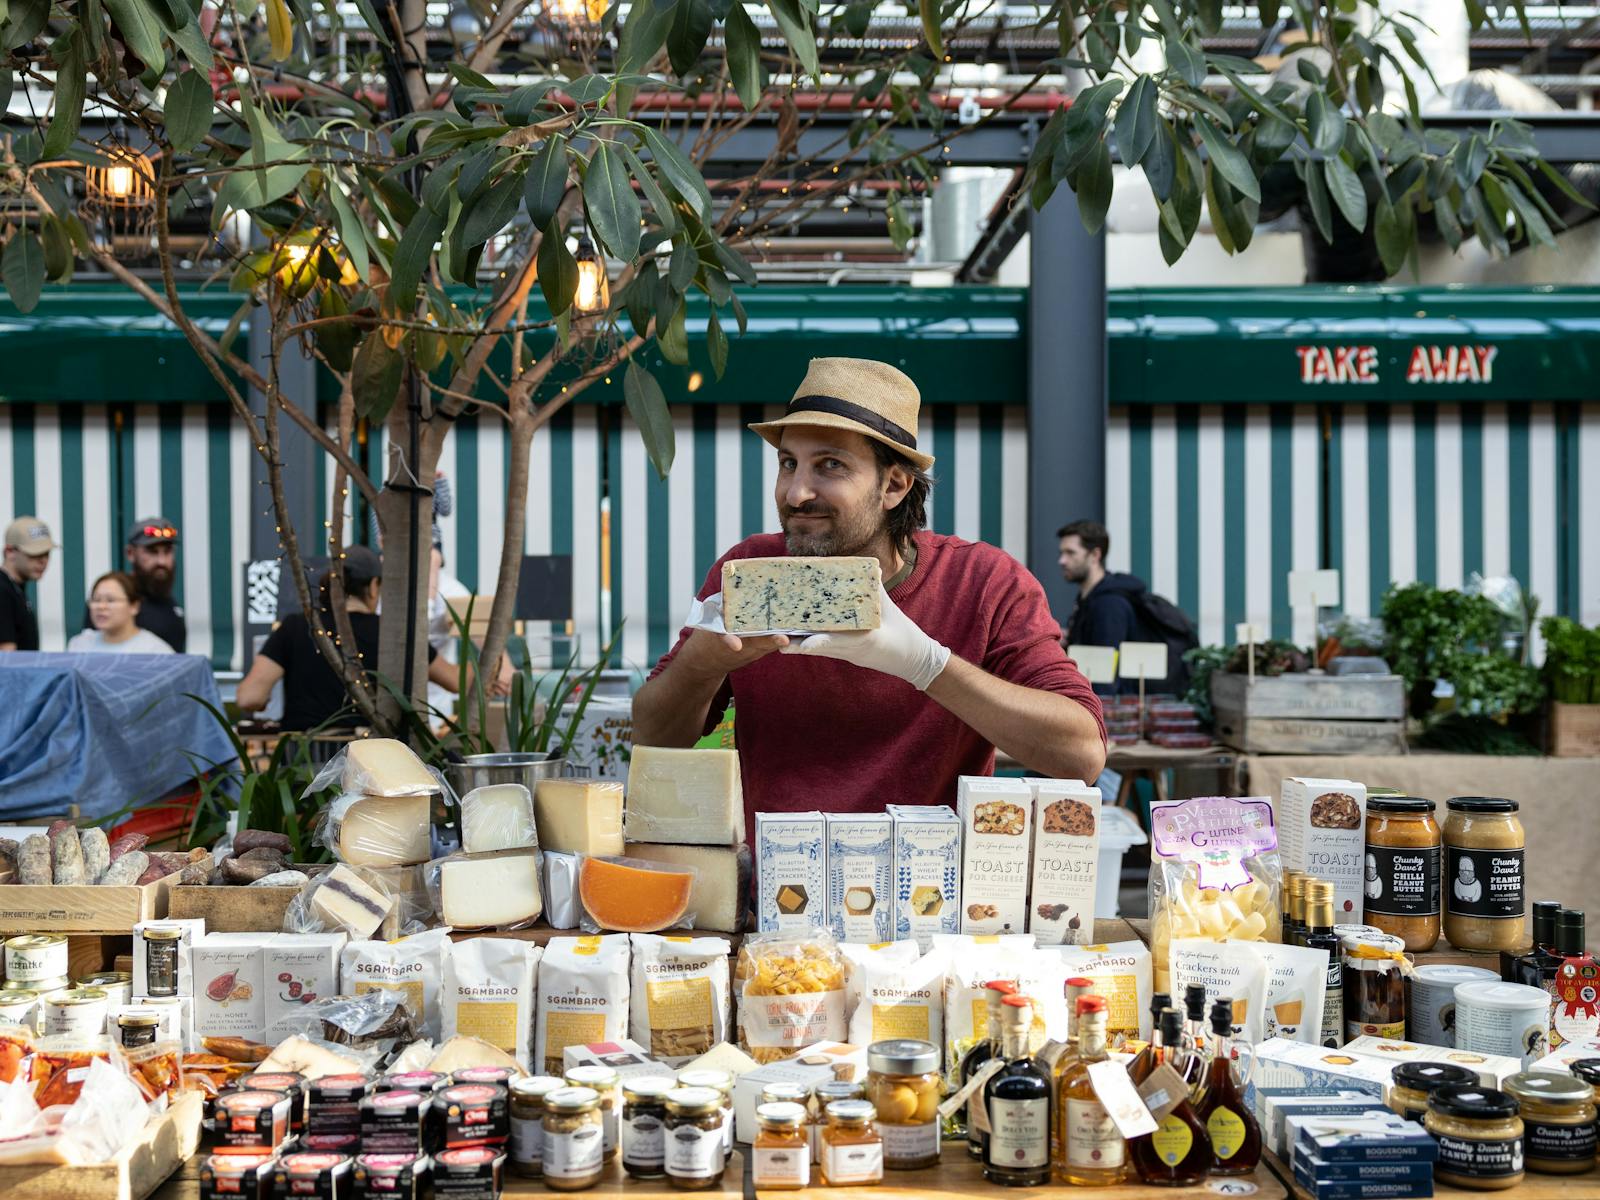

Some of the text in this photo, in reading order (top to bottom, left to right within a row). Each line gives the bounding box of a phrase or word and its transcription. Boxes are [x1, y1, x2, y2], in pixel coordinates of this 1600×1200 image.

[1296, 345, 1498, 384] TAKE AWAY
[1308, 852, 1361, 866] TOAST
[1393, 855, 1424, 866] Chunky
[1492, 857, 1520, 868] Chunky
[970, 859, 1025, 873] TOAST
[1039, 858, 1094, 872] TOAST
[1394, 863, 1423, 871] Dave's
[1307, 866, 1362, 875] FOR CHEESE
[969, 873, 1025, 882] FOR CHEESE
[1038, 872, 1094, 882] FOR CHEESE
[1490, 876, 1521, 884] PEANUT
[357, 963, 423, 976] SGAMBARO
[646, 961, 708, 973] SGAMBARO
[1175, 960, 1241, 976] Crackers with
[1275, 967, 1296, 977] with
[1176, 971, 1231, 986] Parmigiano
[458, 987, 518, 995] SGAMBARO
[872, 989, 931, 998] SGAMBARO
[547, 995, 607, 1005] SGAMBARO
[1440, 1137, 1474, 1153] Chunky
[1365, 1147, 1417, 1155] BOQUERONES
[1476, 1154, 1512, 1162] BUTTER
[1359, 1166, 1411, 1174] BOQUERONES
[1361, 1185, 1412, 1193] BOQUERONES
